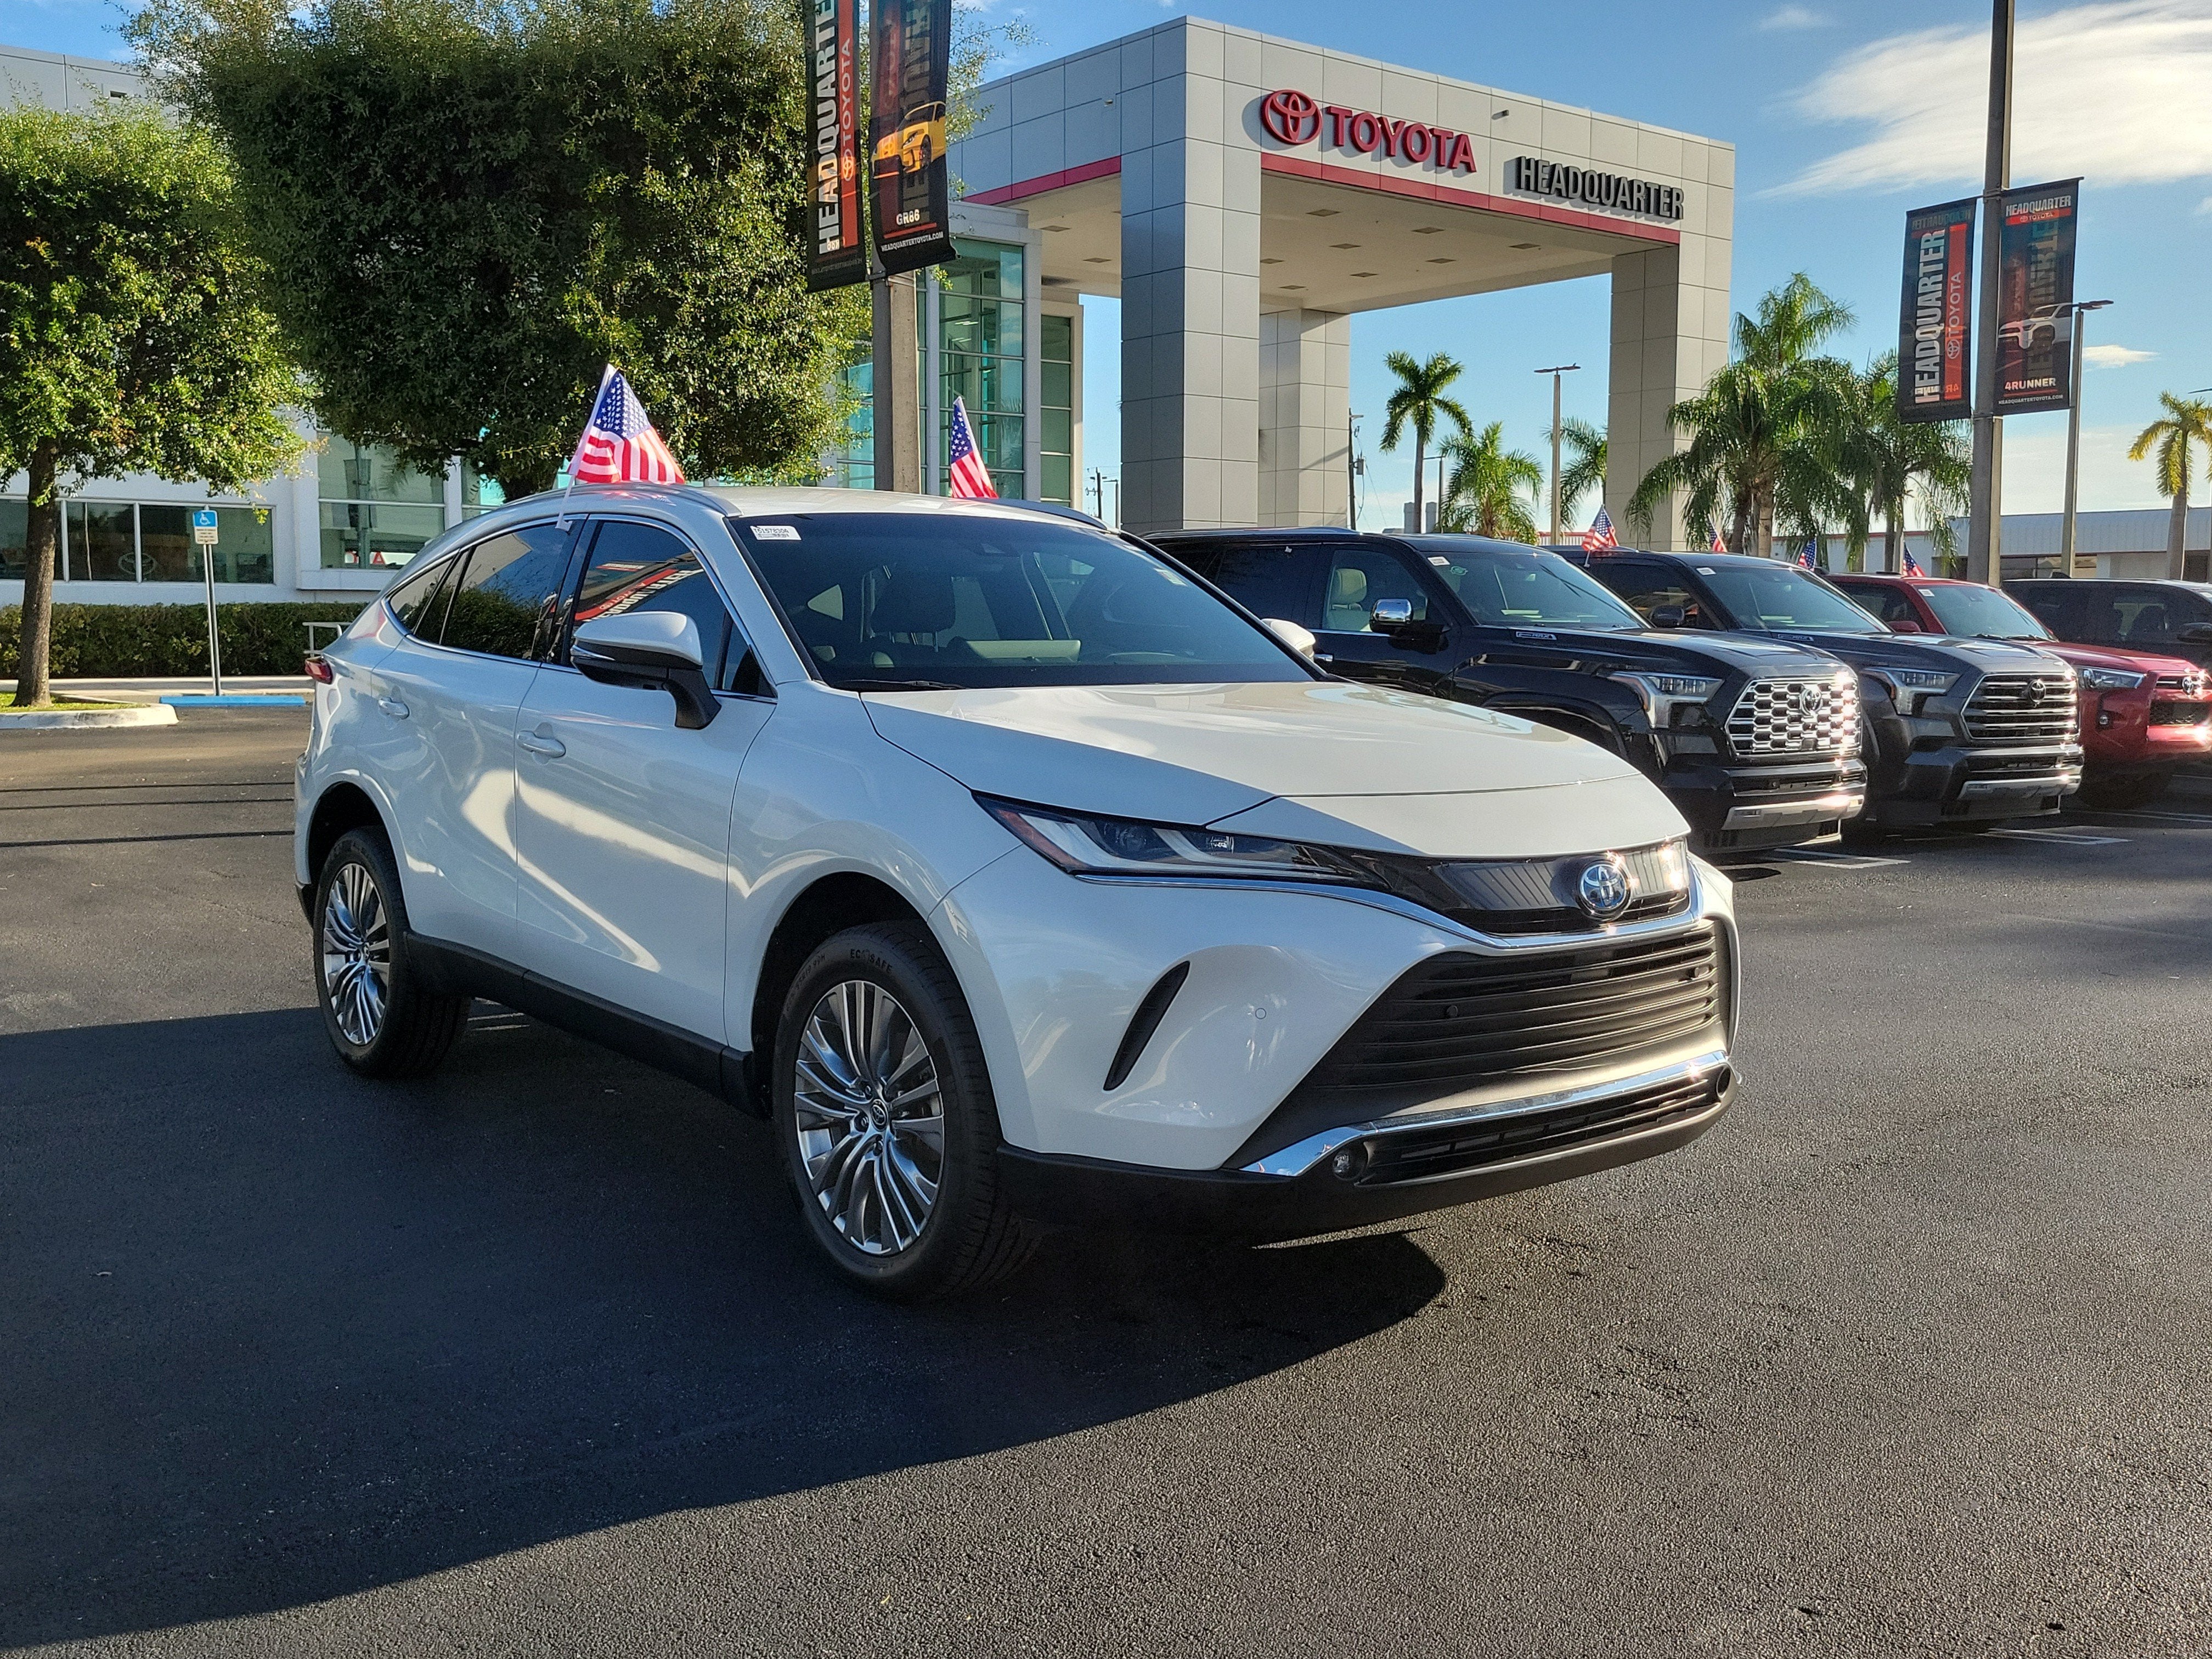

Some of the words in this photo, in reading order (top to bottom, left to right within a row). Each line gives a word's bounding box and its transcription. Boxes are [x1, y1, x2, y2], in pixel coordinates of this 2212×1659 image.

[840, 38, 851, 145] TOYOTA
[815, 0, 839, 254] HEADQUARTE
[1327, 106, 1477, 172] TOYOTA
[1517, 156, 1685, 219] HEADQUARTER
[2006, 195, 2072, 217] HEADQUARTER
[896, 209, 920, 226] GR86
[2029, 212, 2054, 221] TOYOTA
[881, 232, 944, 252] HEADQUARTERTOYOTA.COM
[1915, 228, 1945, 404] HEADQUARTER
[1948, 271, 1961, 337] TOYOTA
[1998, 394, 2063, 405] HEADQUARTERTOYOTA.COM
[2005, 377, 2056, 391] 4RUNNER
